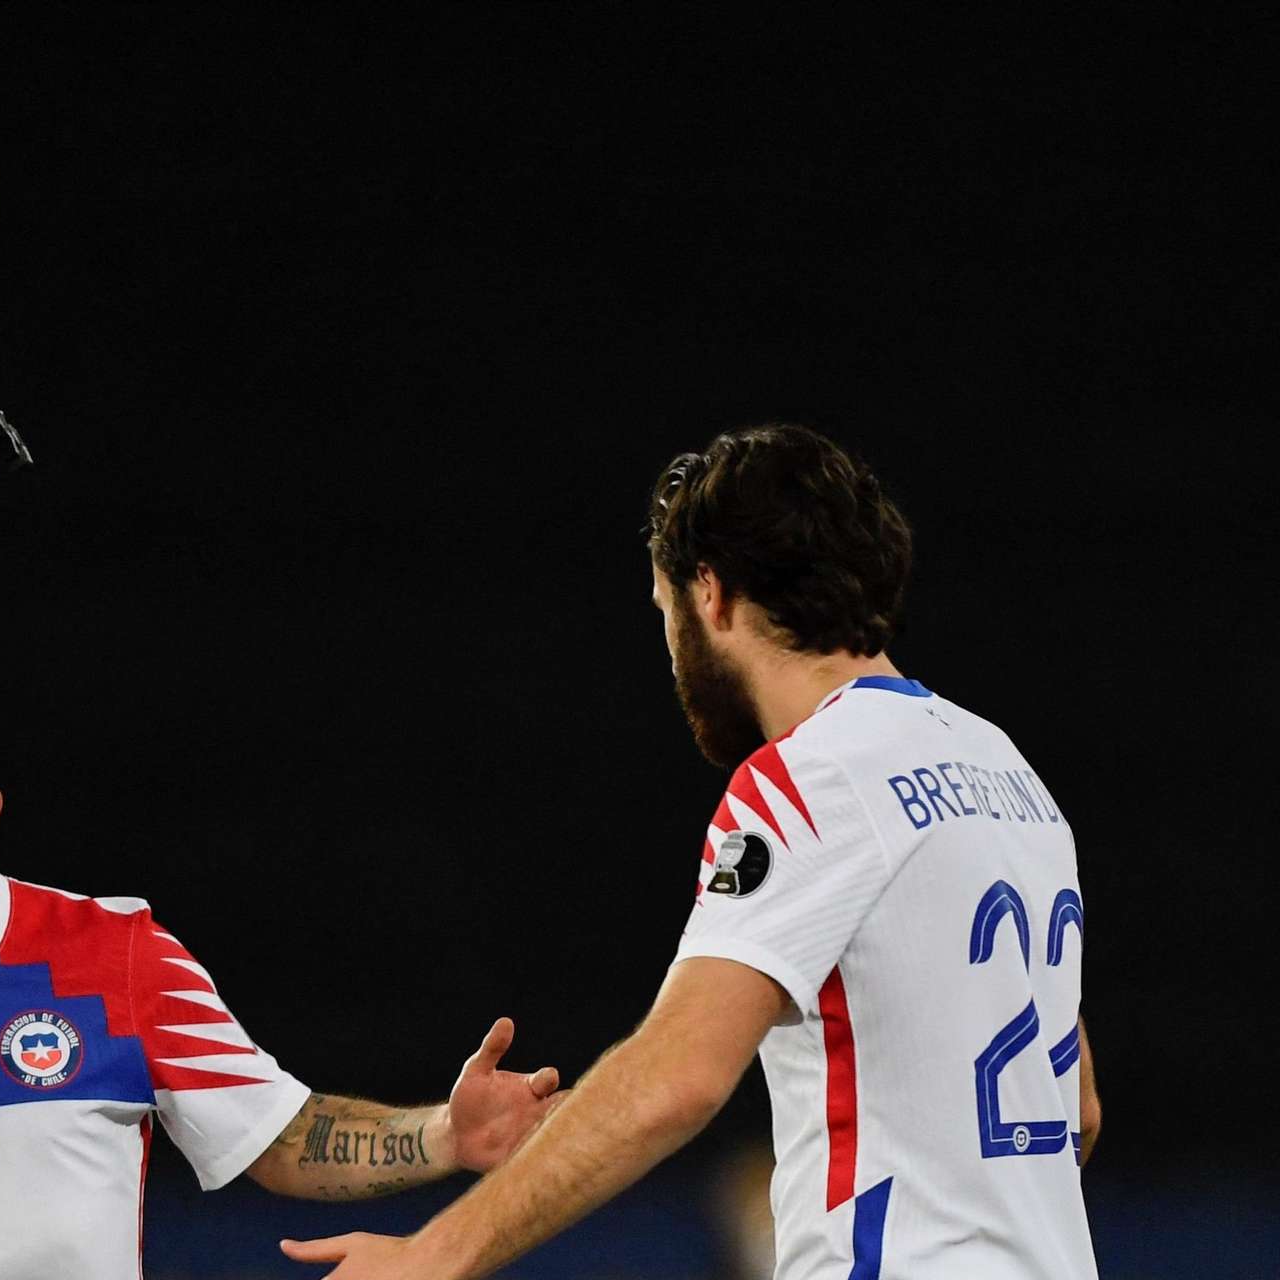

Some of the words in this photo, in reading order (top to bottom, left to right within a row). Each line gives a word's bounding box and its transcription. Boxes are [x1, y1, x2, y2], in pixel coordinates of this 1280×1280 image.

[41, 1012, 55, 1023] DE
[56, 1018, 81, 1050] FUTBOL
[24, 1074, 38, 1086] DE
[41, 1071, 66, 1087] CHILE
[298, 1113, 430, 1170] Marisol
